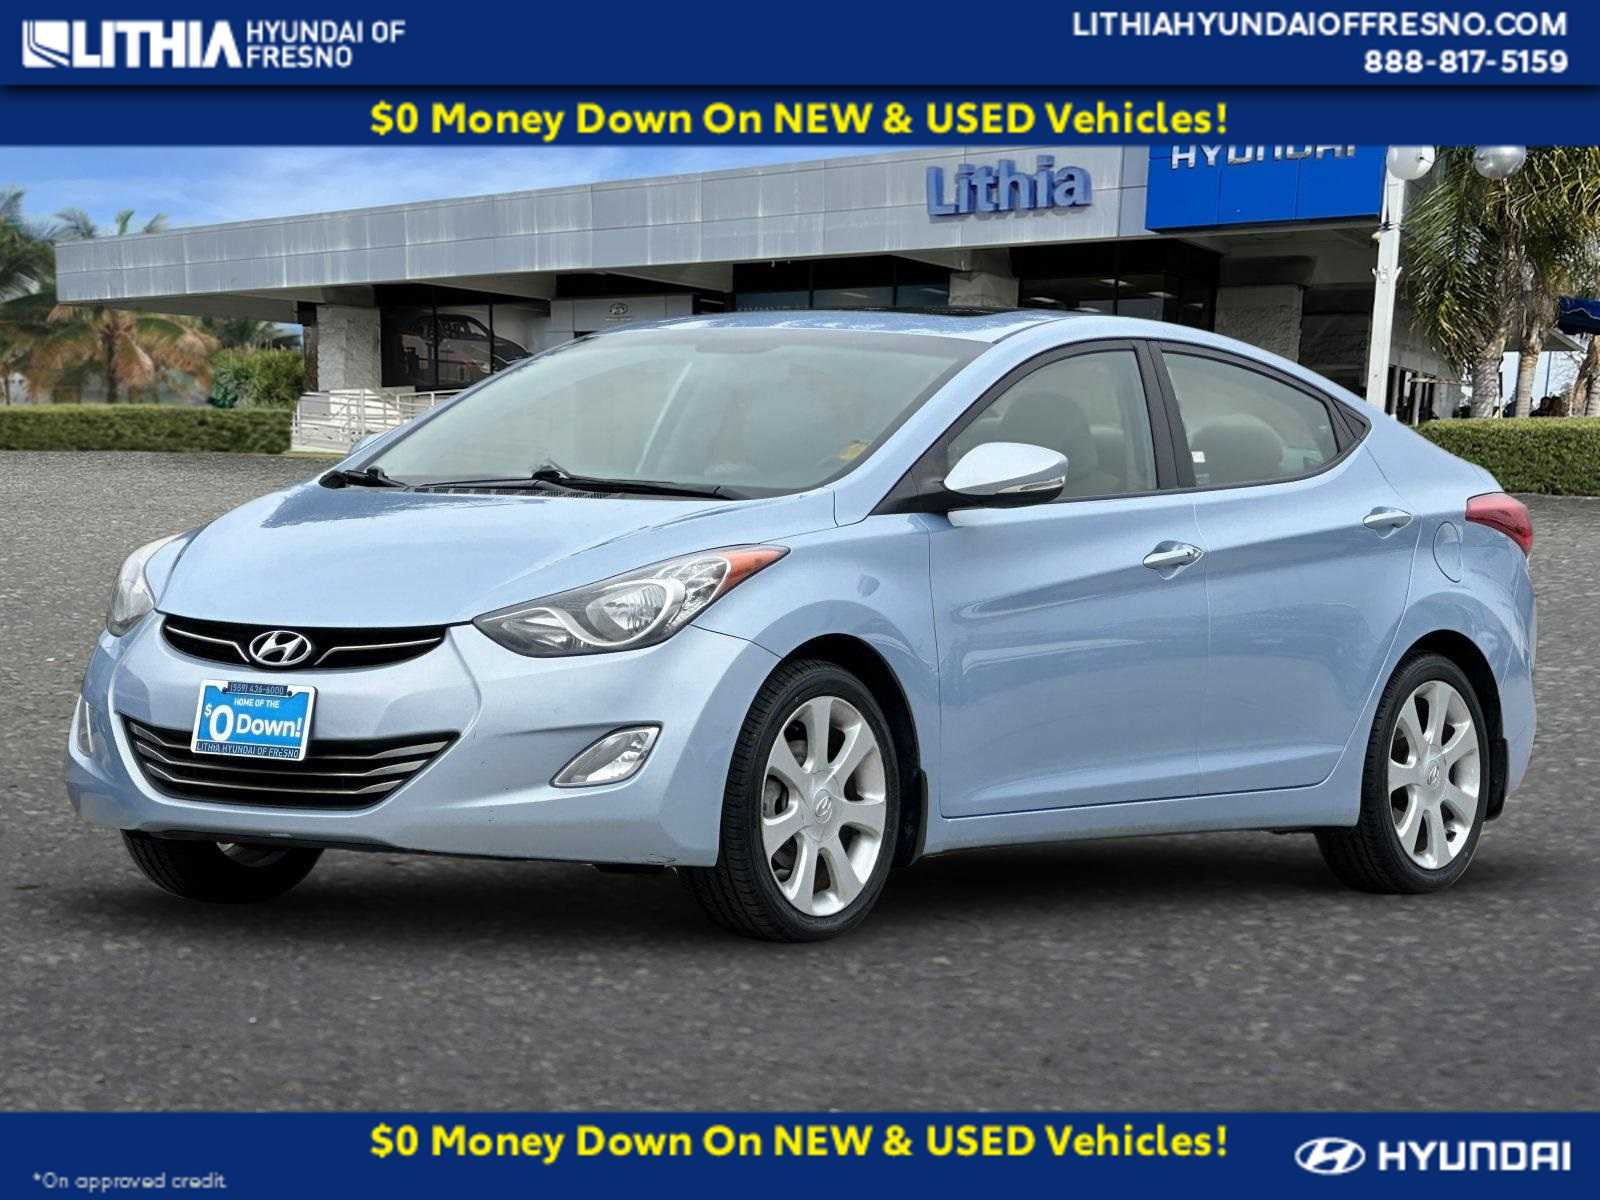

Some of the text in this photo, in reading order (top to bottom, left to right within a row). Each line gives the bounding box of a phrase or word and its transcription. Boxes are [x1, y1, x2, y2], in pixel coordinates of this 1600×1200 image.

[926, 154, 1093, 215] Lithia
[233, 697, 280, 709] HOME OF THE
[236, 713, 302, 738] Down!
[196, 743, 299, 758] LITHIA HYUNDAI OF FRESNO
